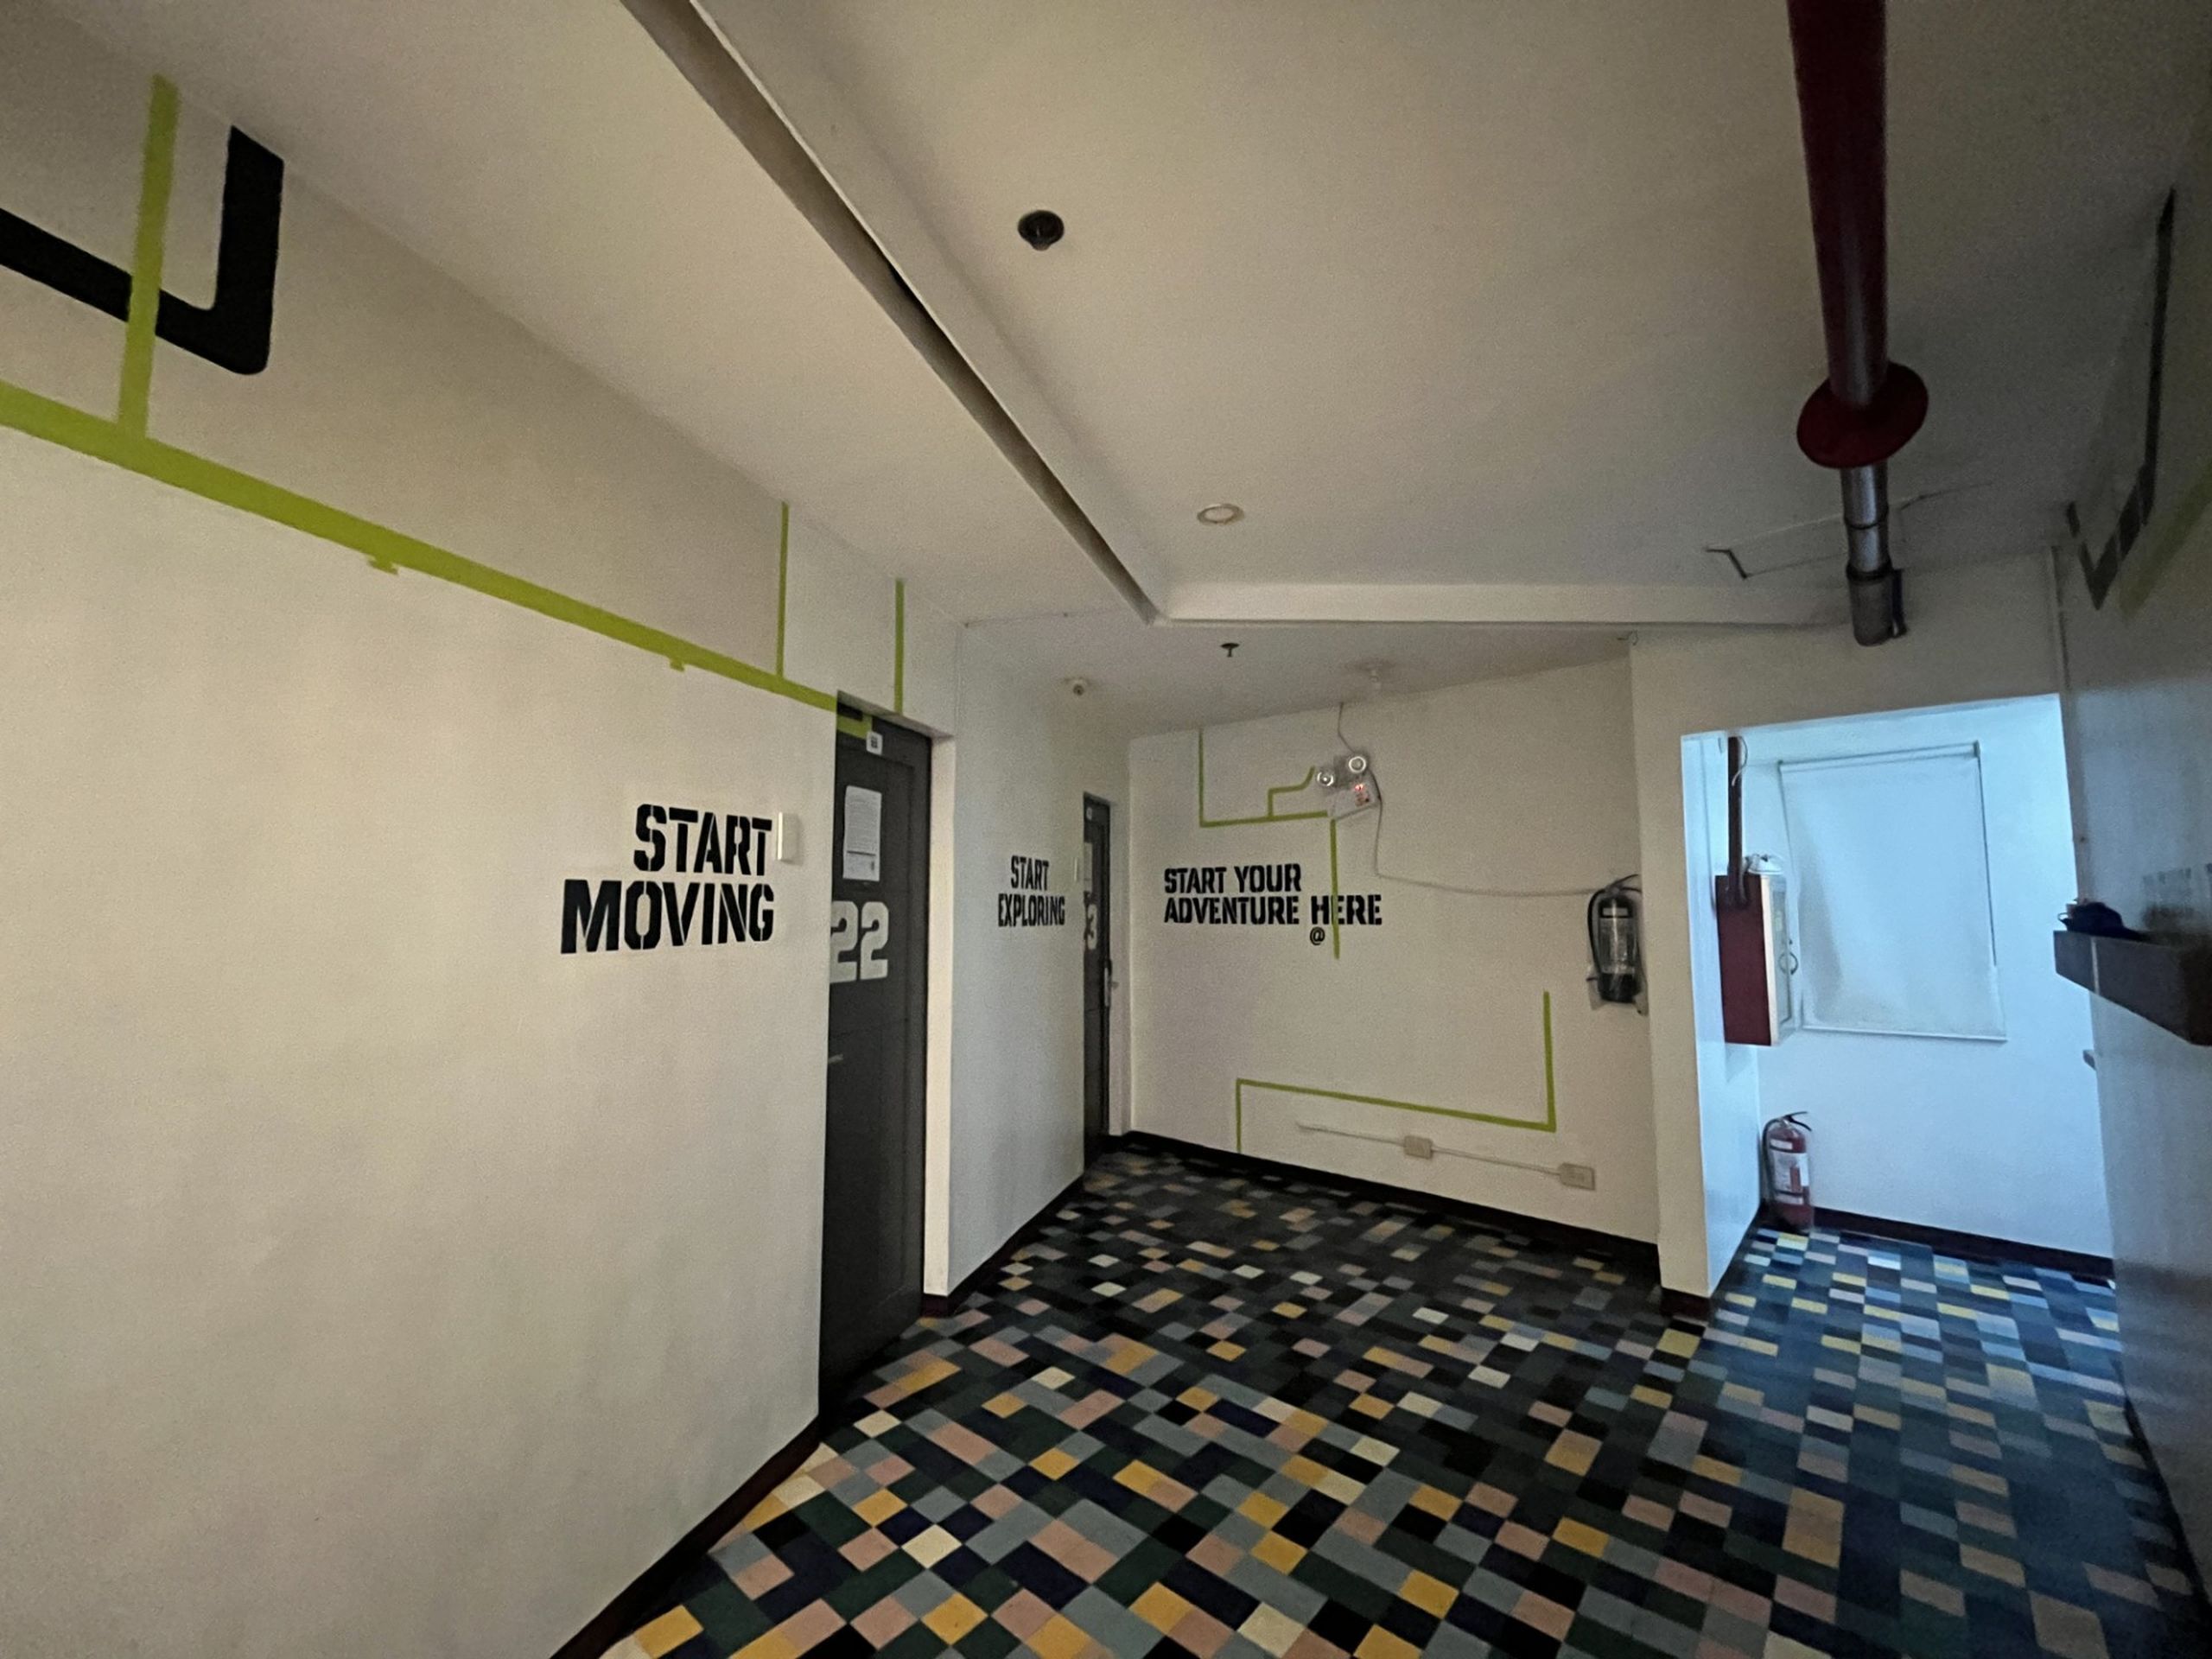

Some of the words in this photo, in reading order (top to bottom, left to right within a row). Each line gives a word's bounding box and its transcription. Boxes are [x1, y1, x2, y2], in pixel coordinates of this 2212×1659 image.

[633, 804, 772, 876] START
[1010, 855, 1050, 891] START
[1164, 867, 1227, 893] START
[1234, 863, 1301, 893] YOUR
[561, 878, 774, 954] MOVING
[998, 893, 1065, 927] EXPLORING
[1164, 896, 1300, 925] ADVENTURE
[1311, 894, 1382, 925] HERE
[830, 900, 889, 983] 22
[1310, 926, 1325, 945] @
